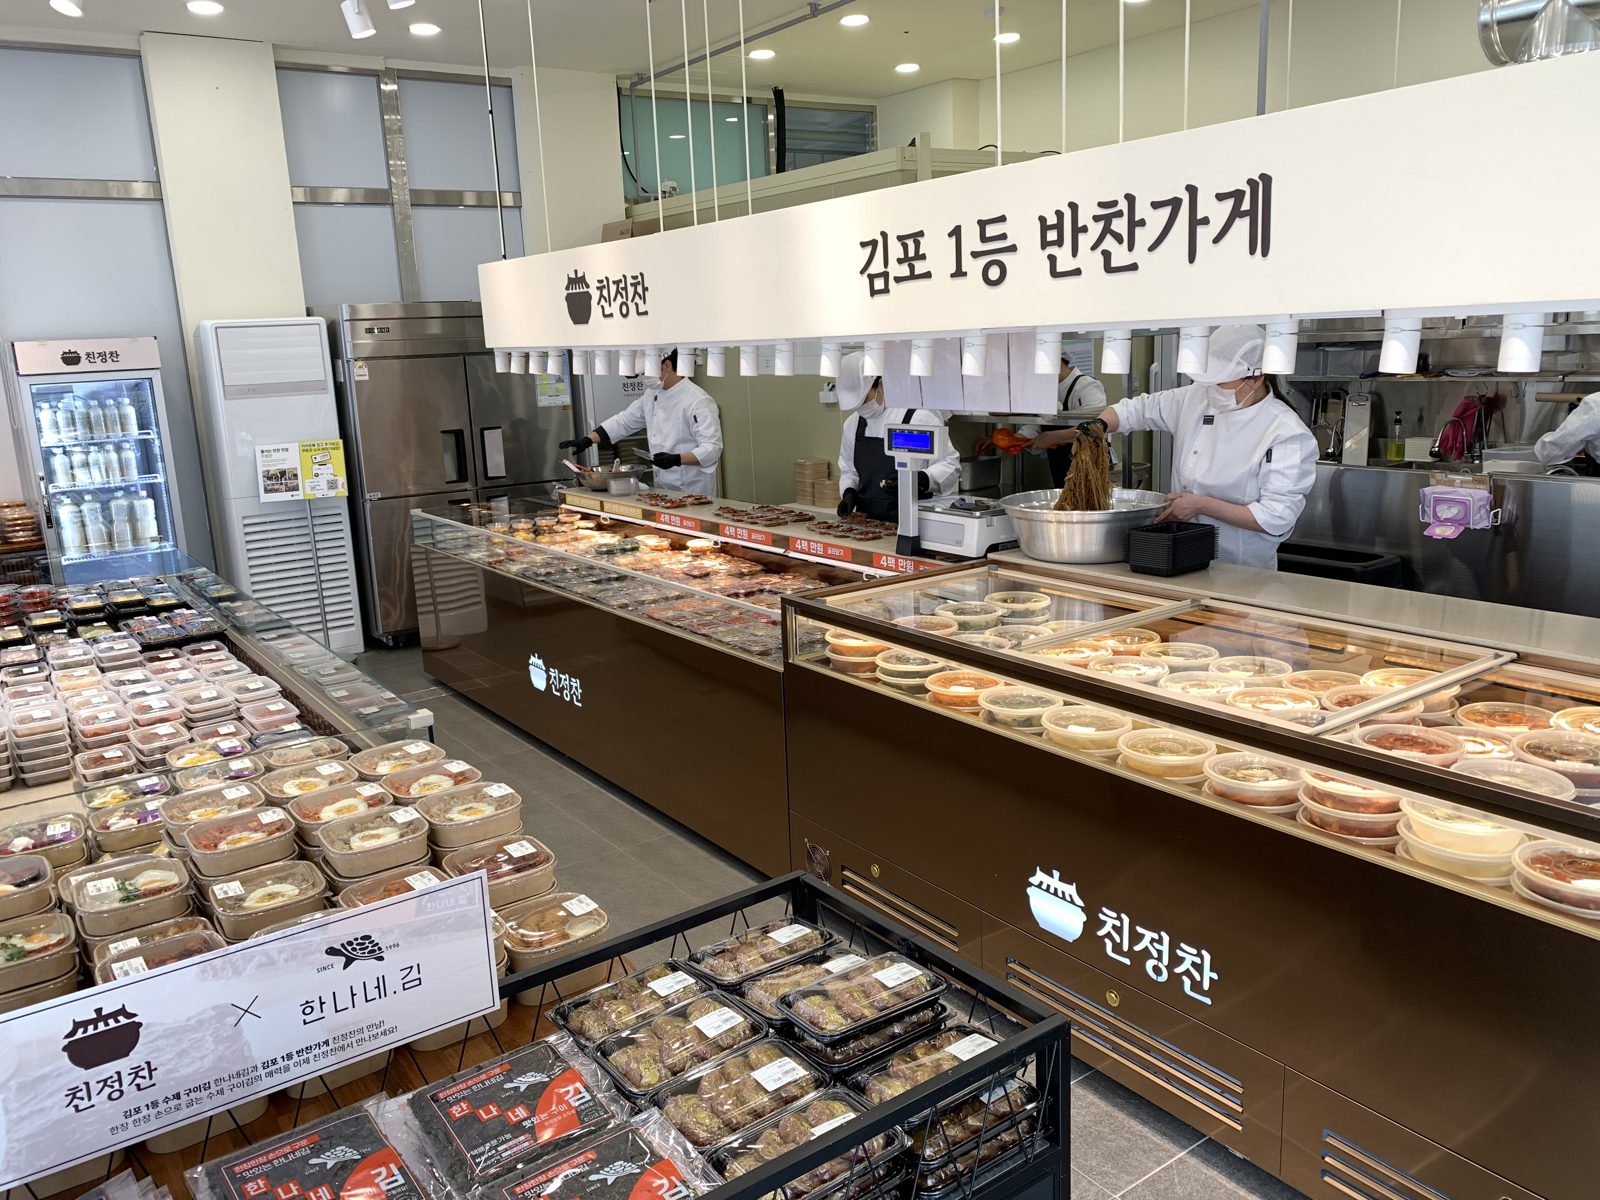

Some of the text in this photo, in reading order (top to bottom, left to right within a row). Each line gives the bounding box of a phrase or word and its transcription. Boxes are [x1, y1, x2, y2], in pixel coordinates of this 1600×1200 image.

[859, 172, 1273, 297] 김포 1등 반찬가게
[595, 271, 649, 319] 친정찬
[84, 350, 120, 364] 친정찬
[622, 381, 644, 392] 친정찬
[660, 513, 670, 524] 4팩
[670, 515, 681, 526] 만원
[724, 526, 735, 537] 4팩
[737, 528, 749, 540] 만원
[795, 540, 808, 552] 4팩
[810, 541, 824, 555] 만원
[880, 555, 896, 568] 4팩
[898, 558, 914, 573] 만원
[549, 667, 582, 707] 친정찬
[316, 942, 400, 974] SINCE 1996
[1096, 906, 1219, 1005] 친정찬
[300, 963, 422, 1026] 한나네.김
[109, 1025, 398, 1136] 한장 한장 손으로 굽는 수제 구이김의 매력을 이제 친정찬에서 만나보세요!
[122, 1019, 385, 1120] 김포 1등 수제 구이김 한나네김과 김포 1등 반찬가게 친정찬의 만남!
[64, 1061, 158, 1113] 친정찬
[522, 1112, 549, 1129] 맛있는
[370, 1163, 405, 1191] 김
